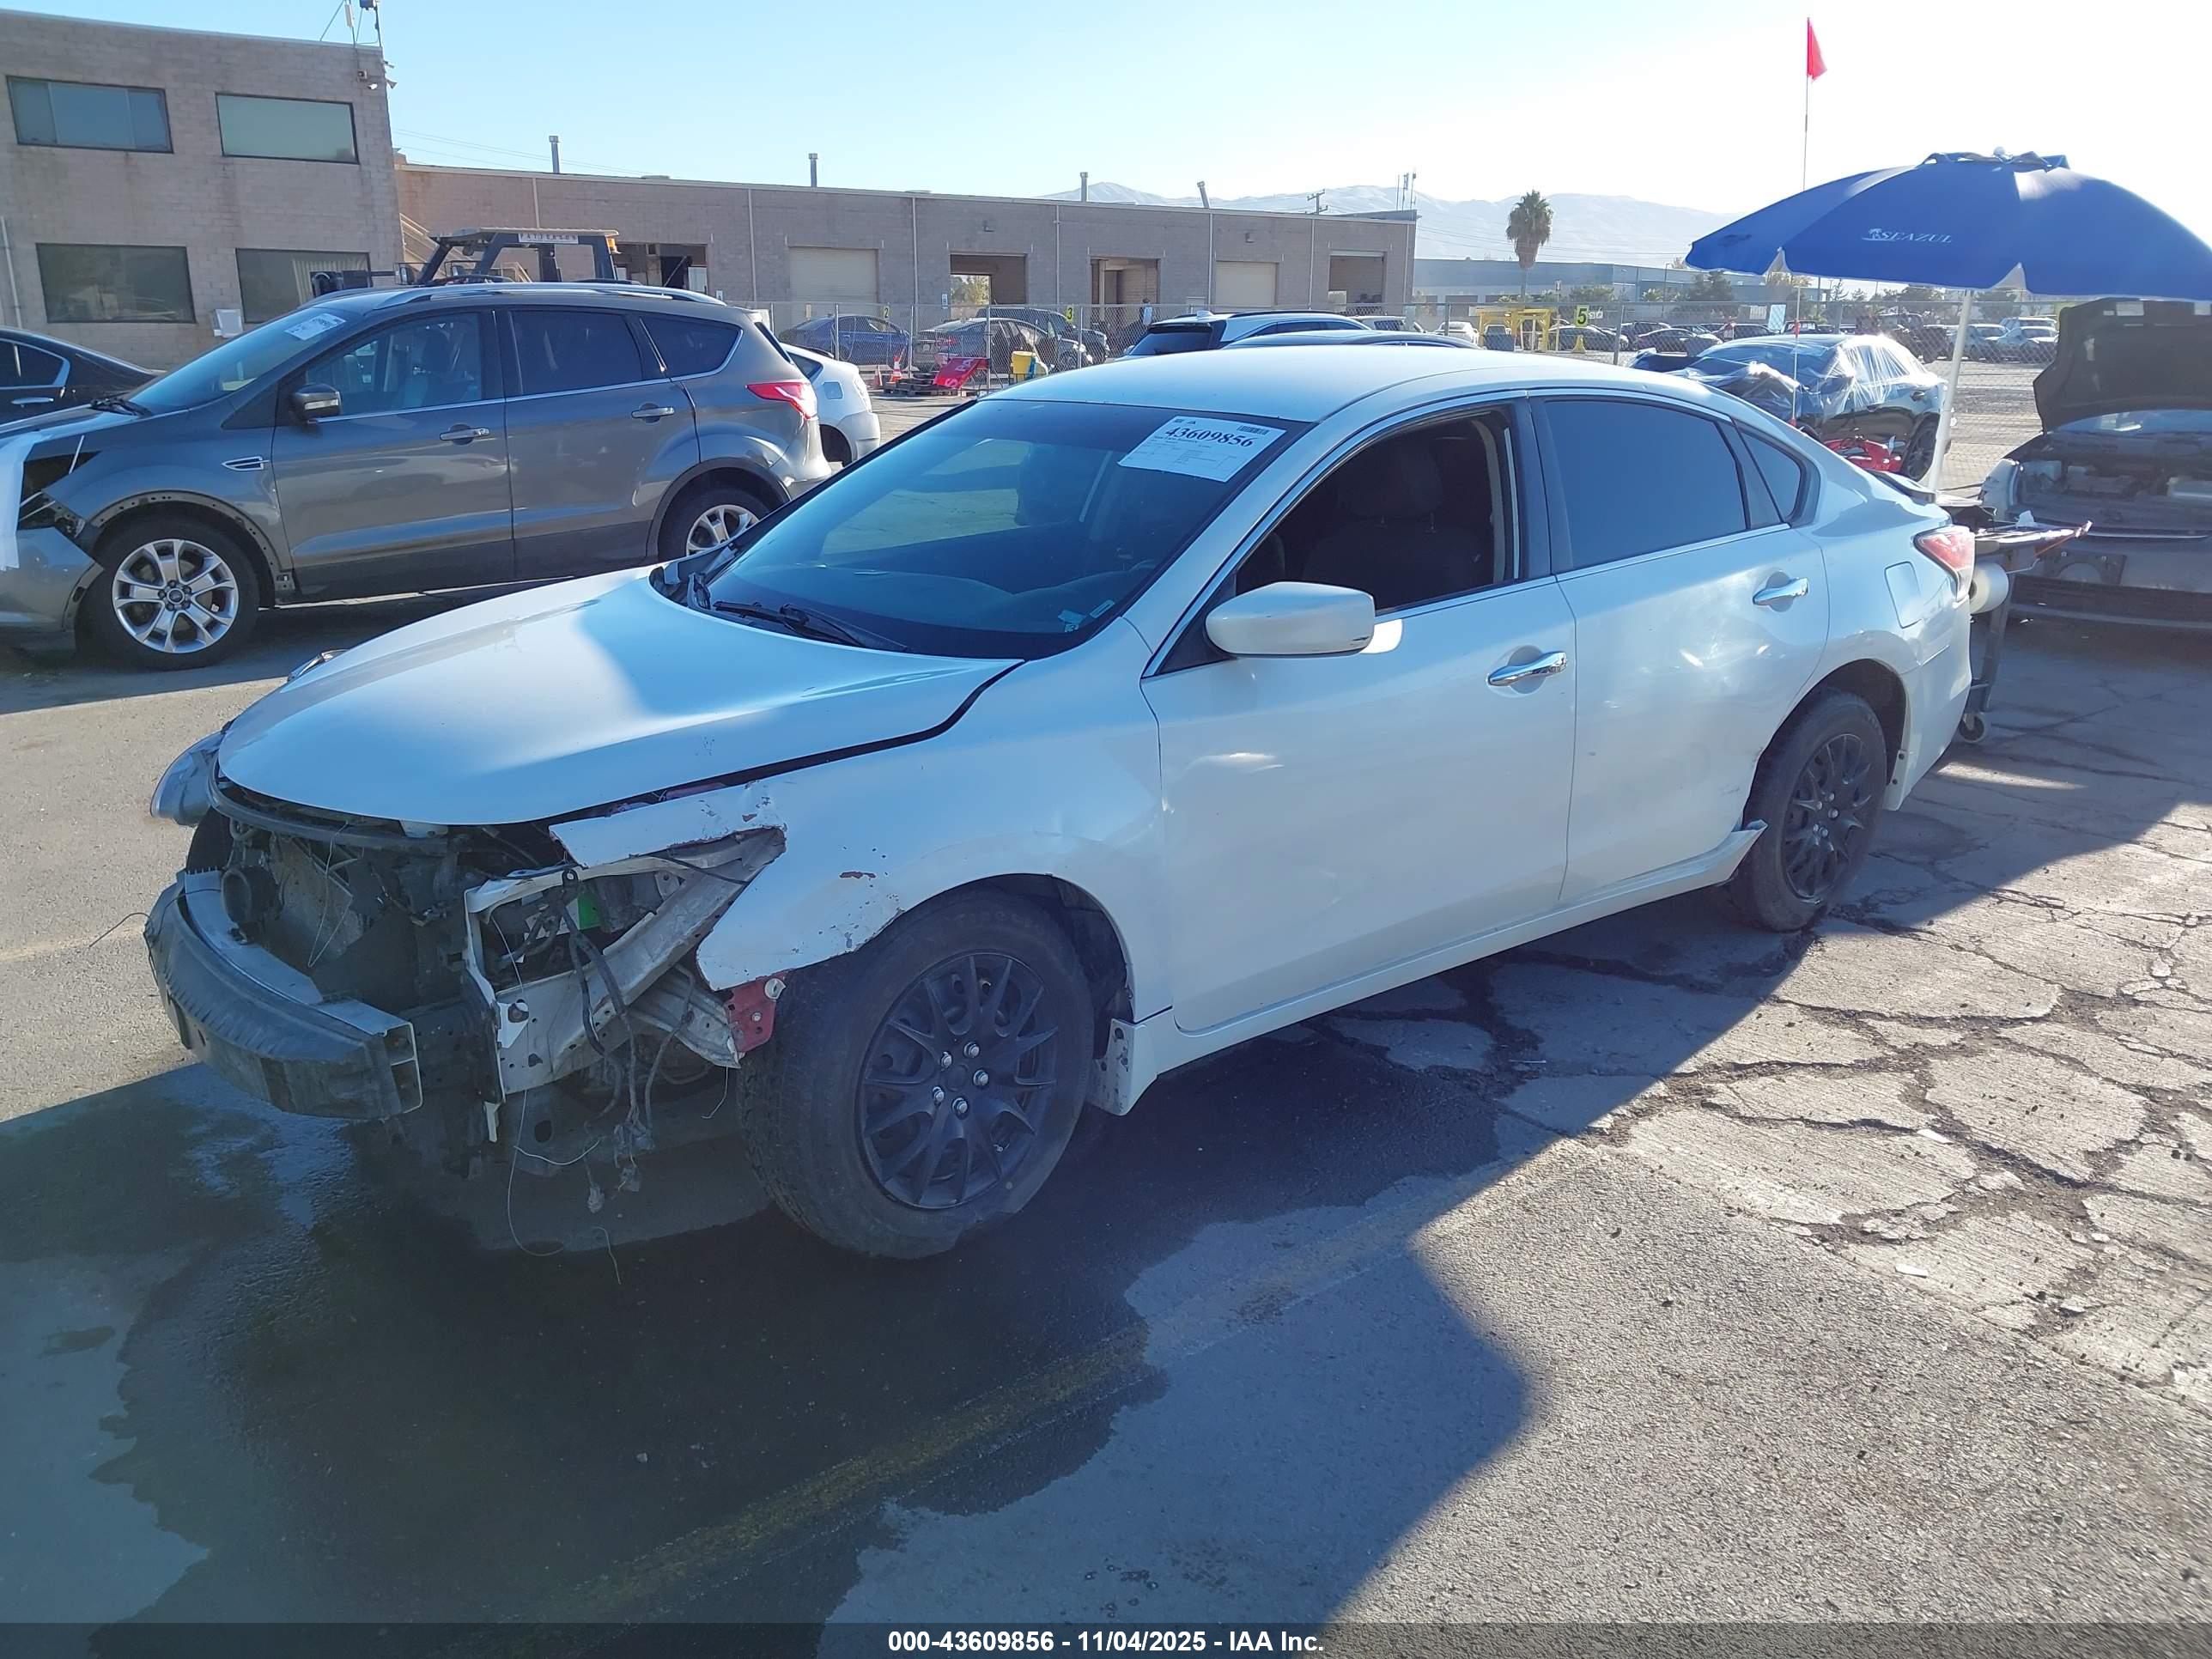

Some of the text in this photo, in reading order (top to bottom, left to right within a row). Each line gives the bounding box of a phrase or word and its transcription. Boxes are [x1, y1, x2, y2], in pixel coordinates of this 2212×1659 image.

[1882, 230, 1951, 243] SEAZUL
[884, 307, 890, 319] 2
[1066, 307, 1073, 319] 3
[1577, 308, 1587, 325] 5
[1166, 426, 1255, 447] 43609856
